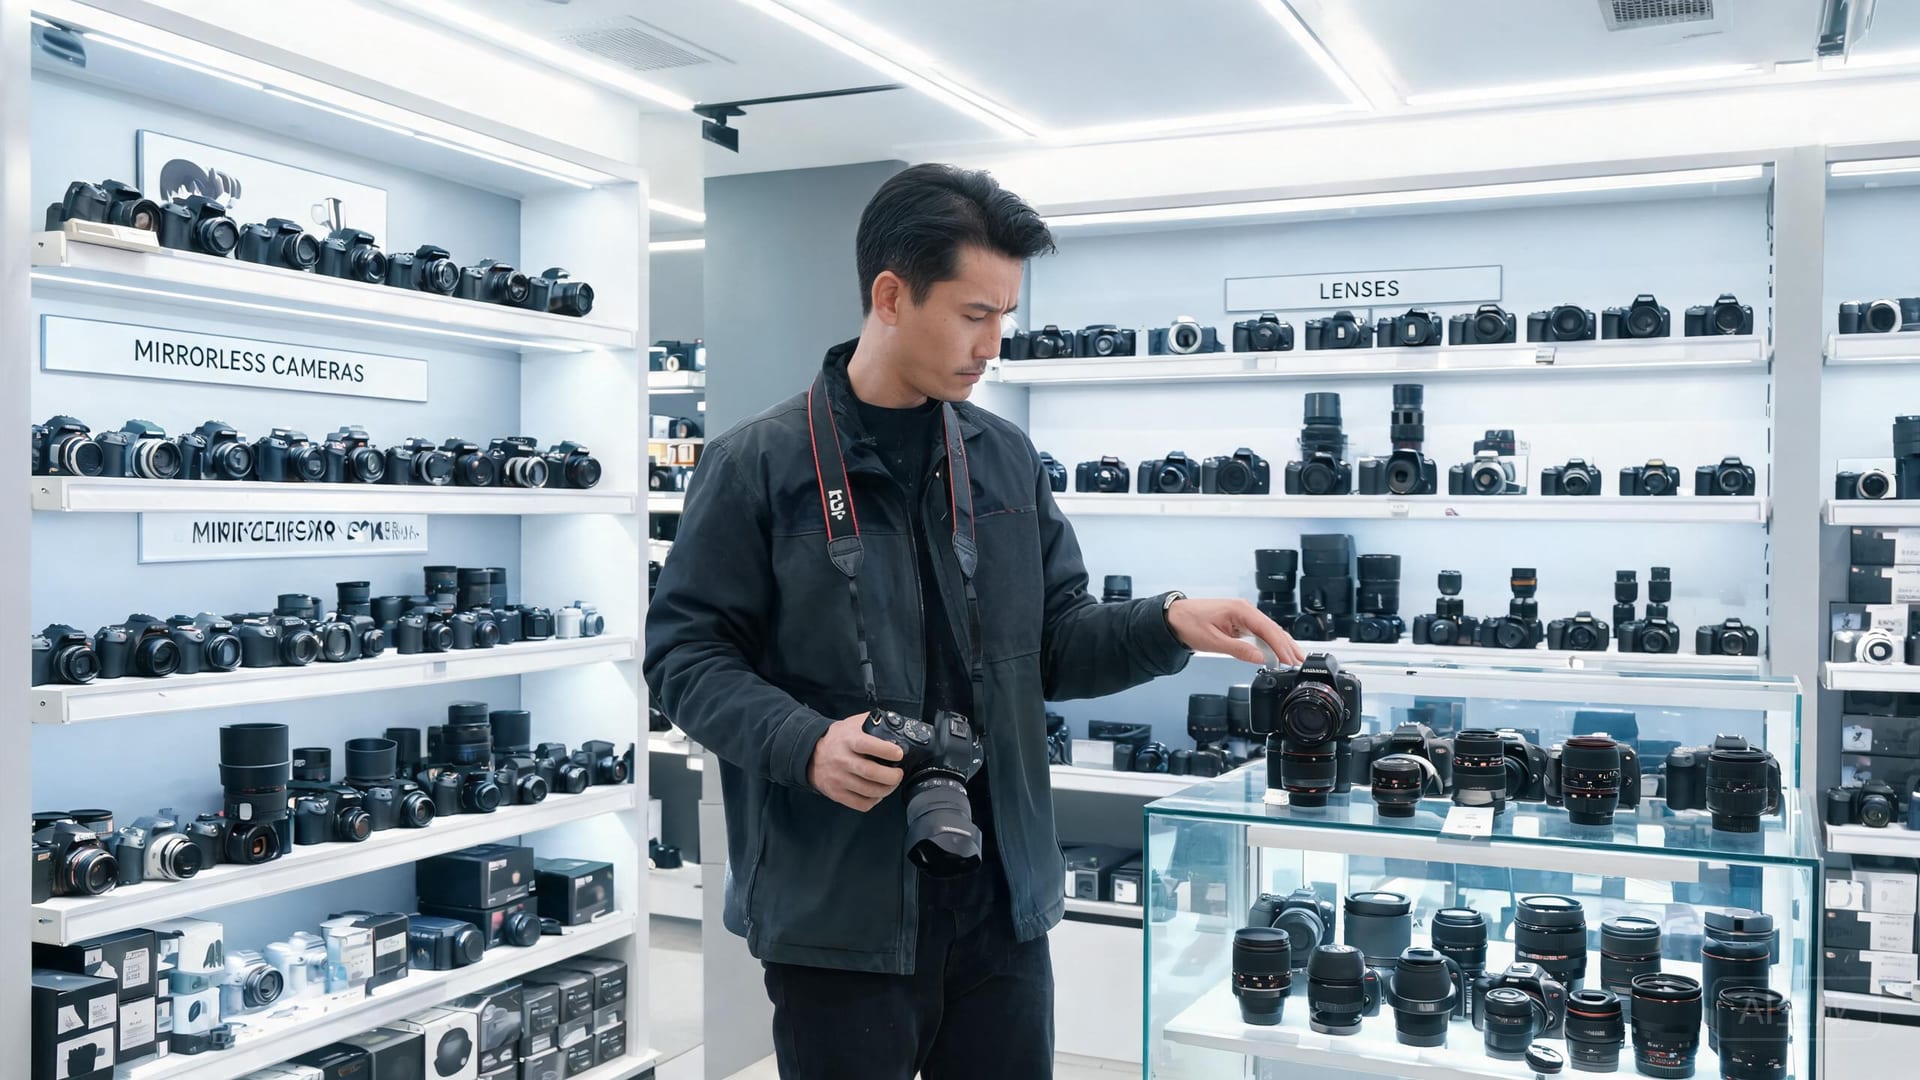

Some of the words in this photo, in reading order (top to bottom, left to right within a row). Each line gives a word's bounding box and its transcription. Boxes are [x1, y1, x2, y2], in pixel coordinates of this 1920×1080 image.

[1319, 280, 1400, 300] LENSES
[134, 339, 266, 373] MIRRORLESS
[272, 354, 365, 383] CAMERAS
